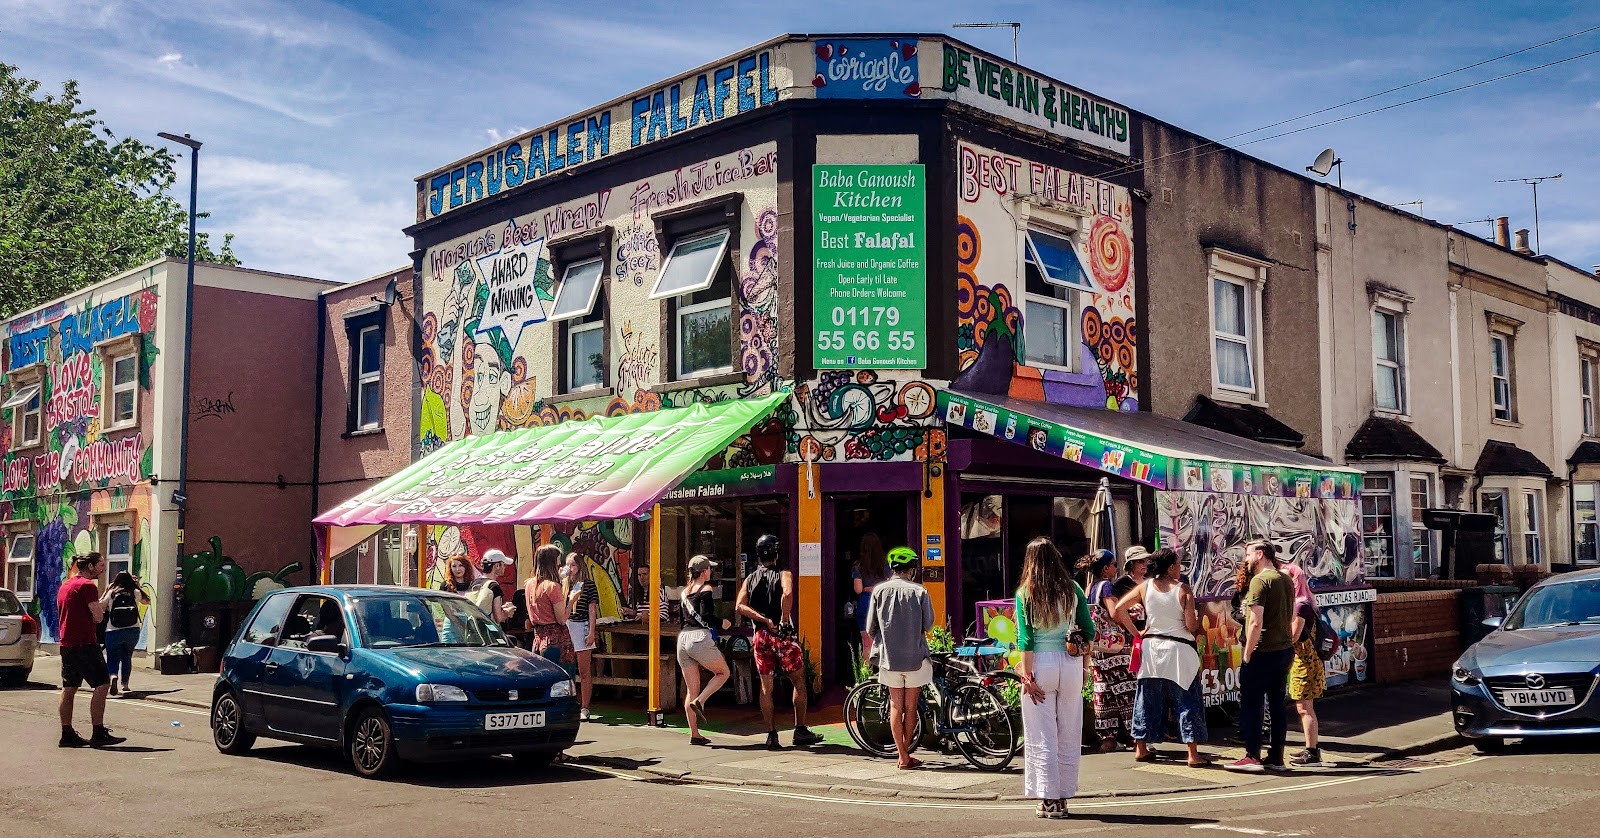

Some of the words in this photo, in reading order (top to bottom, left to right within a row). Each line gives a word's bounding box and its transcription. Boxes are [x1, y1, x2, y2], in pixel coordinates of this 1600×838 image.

[942, 44, 971, 92] BE
[973, 57, 1039, 116] VEGAN
[1041, 82, 1058, 128] &
[1060, 92, 1127, 143] HEALTHY
[430, 110, 612, 216] JERUSALEM
[631, 52, 779, 147] FALAFEL
[819, 170, 854, 188] Baba
[857, 170, 916, 188] Ganoush
[961, 146, 1021, 203] BEST
[1031, 161, 1123, 220] FALAFEL
[630, 169, 691, 219] Fresh
[833, 191, 903, 208] Kitchen
[503, 218, 538, 248] Best
[544, 188, 612, 239] Wrap!
[818, 213, 880, 224] Vegan/Vegetarian
[881, 213, 915, 224] Specialist
[821, 230, 849, 249] Best
[854, 232, 915, 251] Falafal
[490, 252, 529, 288] AWARD
[817, 258, 836, 269] Fresh
[836, 258, 854, 269] Juice
[856, 258, 868, 269] and
[870, 258, 896, 270] Organic
[897, 258, 919, 269] Coffee
[838, 274, 855, 285] Open
[856, 274, 873, 285] Early
[874, 274, 882, 284] til
[883, 274, 898, 284] Late
[490, 284, 533, 317] WINNING
[830, 287, 850, 298] Phone
[851, 287, 875, 298] Orders
[876, 287, 906, 298] Welcome
[831, 306, 900, 327] 01179
[10, 326, 50, 371] BEST
[818, 330, 845, 351] 55
[852, 330, 880, 351] 66
[888, 330, 915, 351] 55
[872, 357, 896, 365] Ganoush
[51, 352, 93, 397] LOVE
[46, 384, 100, 432] BRISTOL
[1, 456, 30, 493] LOVE
[34, 450, 60, 490] THE
[72, 431, 143, 485] COMMUNITY
[662, 487, 696, 500] erusalem
[698, 484, 725, 498] Falafel
[1325, 592, 1352, 605] NICHOLAS
[1353, 590, 1369, 602] ROAD
[1510, 692, 1538, 704] YB14
[1540, 691, 1567, 703] UYD
[490, 714, 519, 728] S377
[522, 713, 542, 726] CTC
